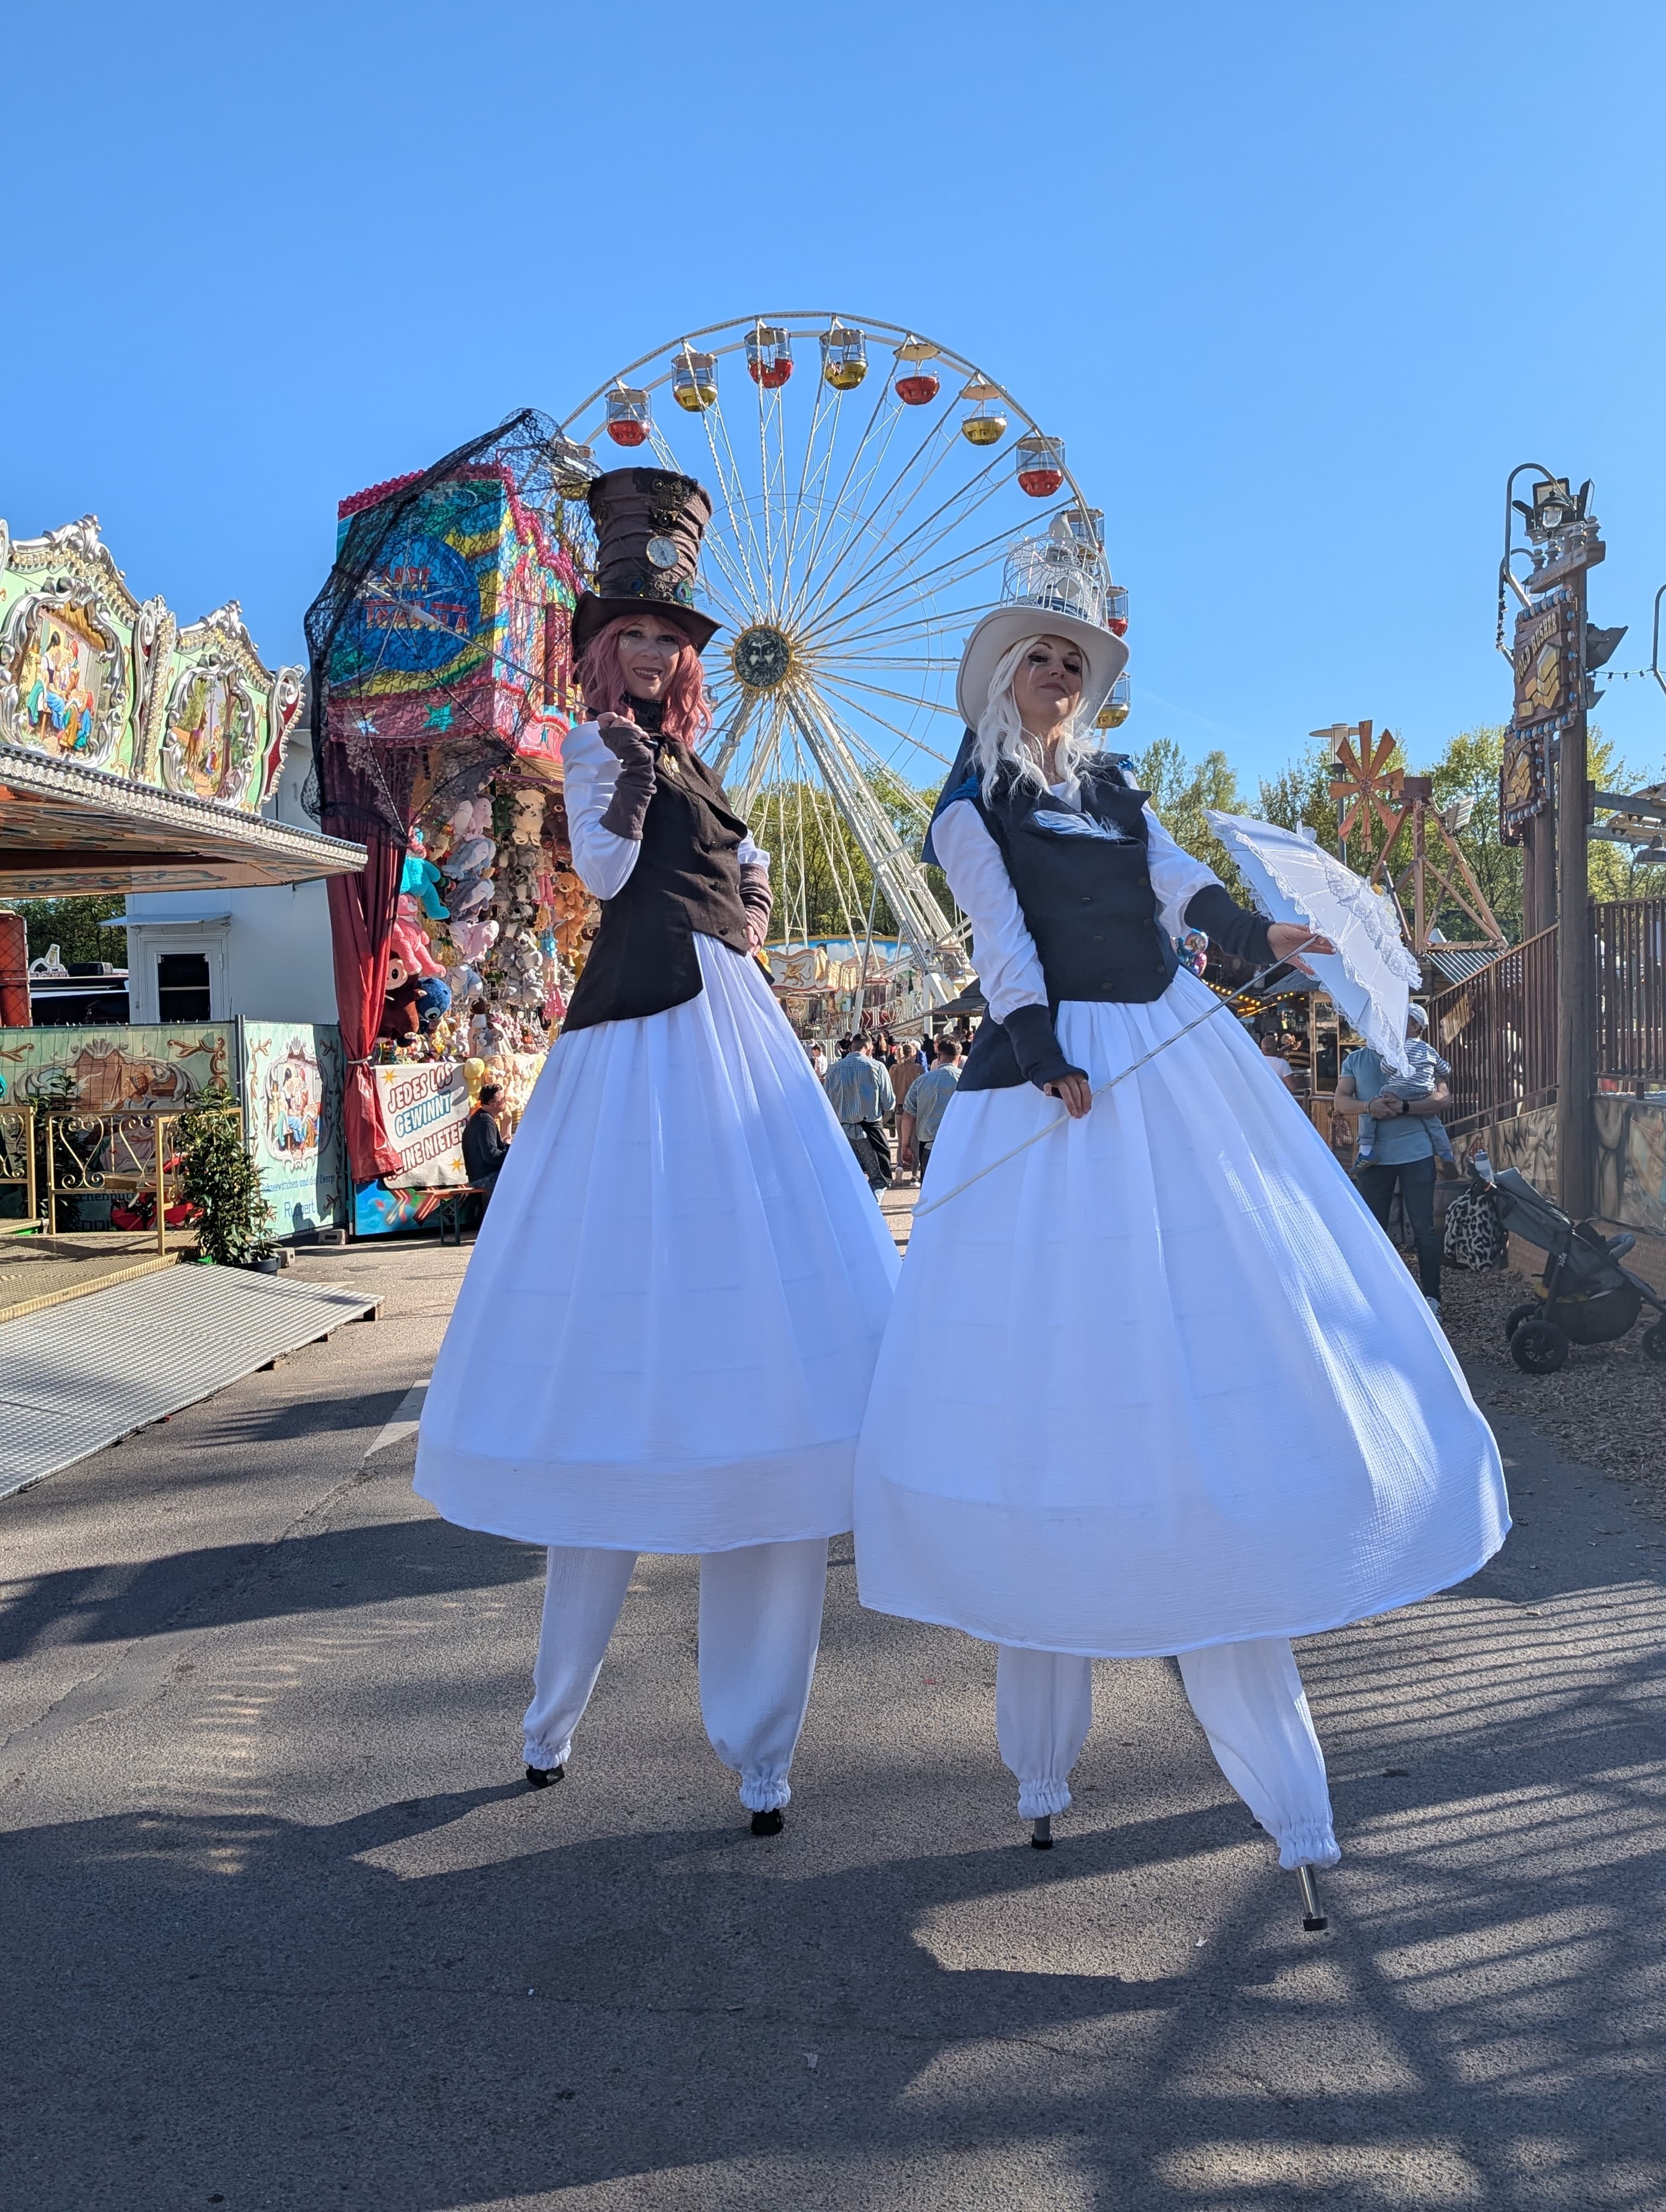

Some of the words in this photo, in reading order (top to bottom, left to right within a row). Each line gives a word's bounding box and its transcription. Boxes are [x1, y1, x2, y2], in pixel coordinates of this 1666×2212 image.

[1516, 646, 1530, 682] GOLD
[1530, 613, 1558, 655] RUSHER
[388, 1072, 428, 1113] JEDES
[430, 1063, 453, 1092] LOS
[395, 1090, 451, 1138] GEWINNT
[299, 1176, 309, 1187] und
[284, 1198, 316, 1219] Ruppert
[1558, 1252, 1567, 1267] Joie
